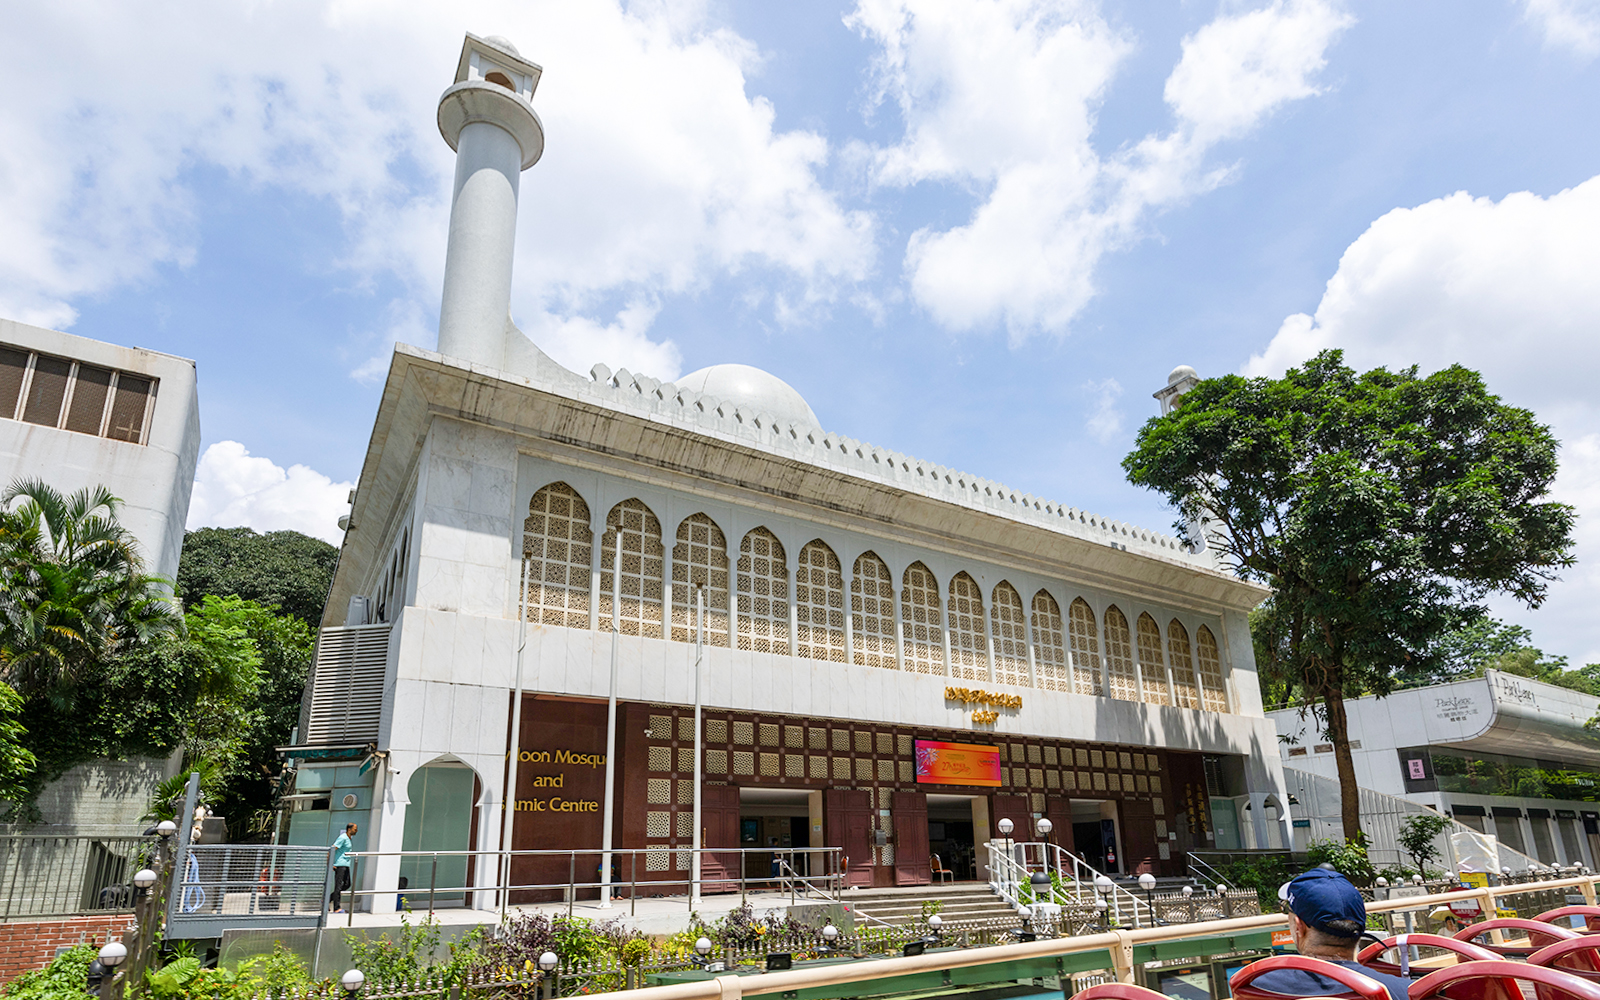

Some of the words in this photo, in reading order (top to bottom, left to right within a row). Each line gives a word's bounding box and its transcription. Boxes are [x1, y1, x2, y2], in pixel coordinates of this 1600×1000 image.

[554, 750, 607, 769] Mosqu
[533, 774, 563, 787] and
[549, 797, 599, 812] Centre
